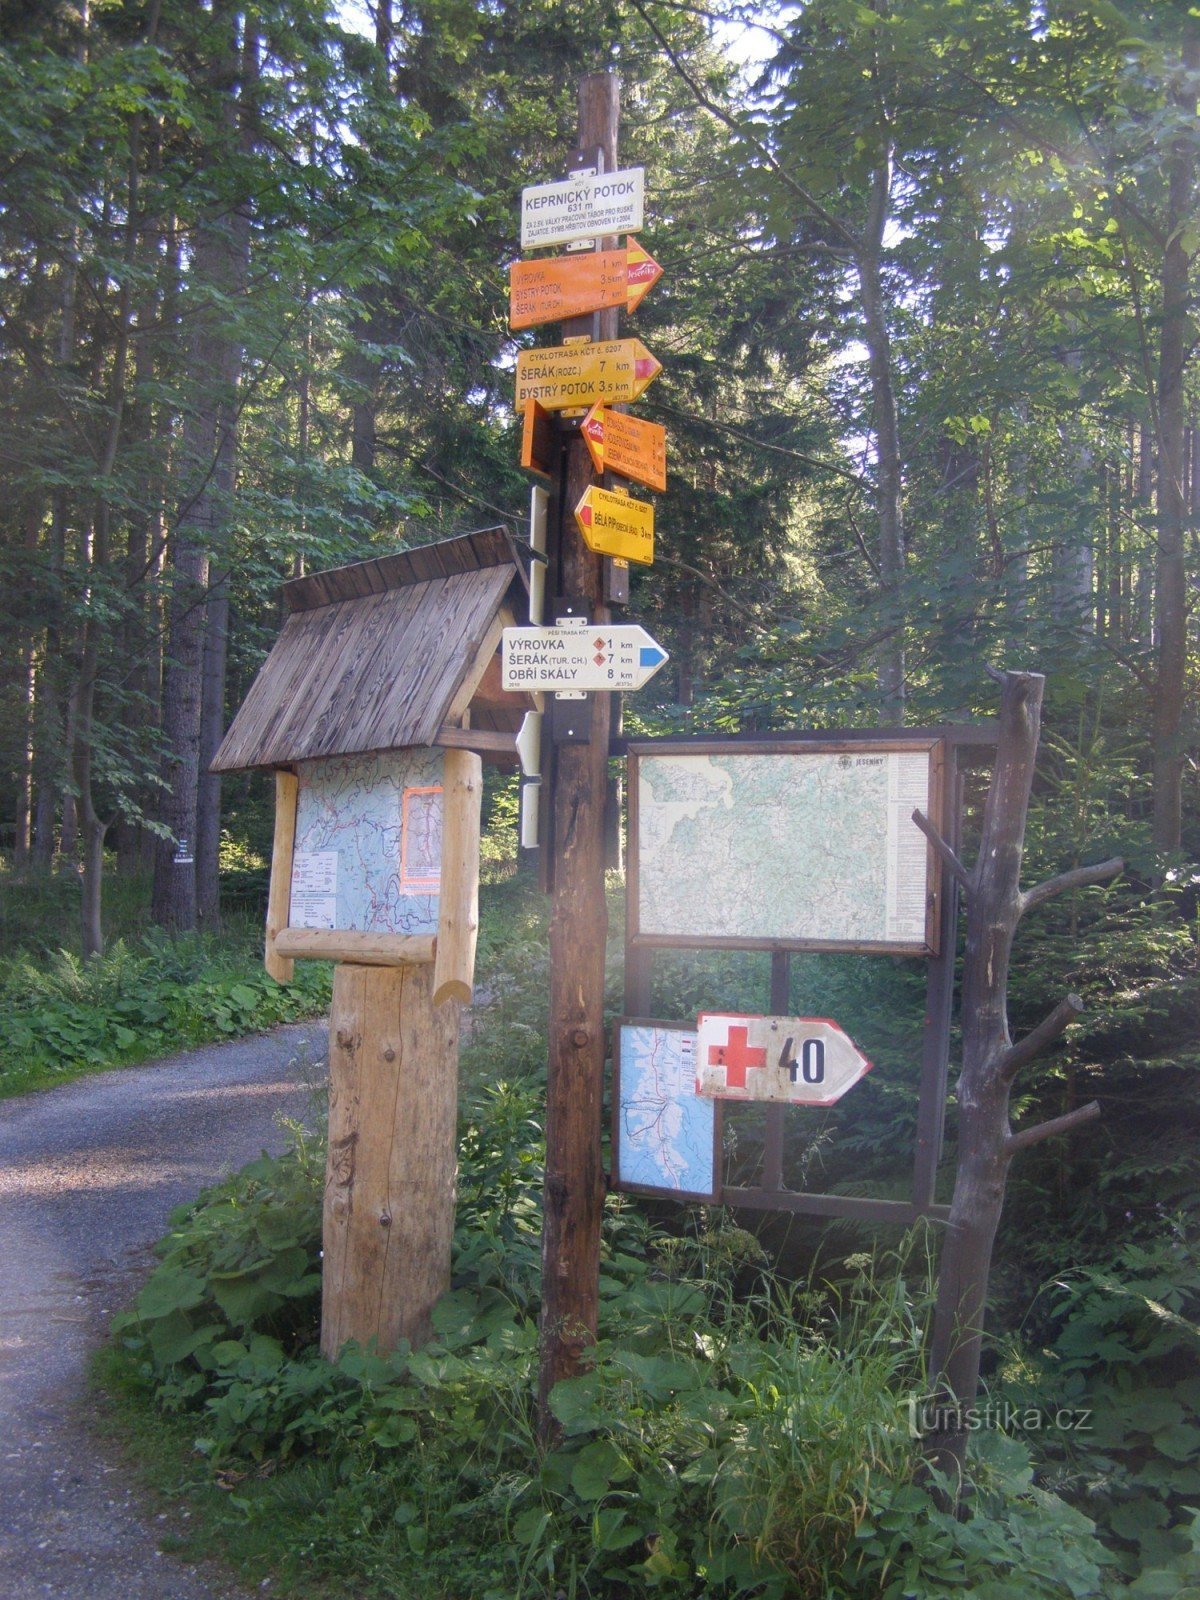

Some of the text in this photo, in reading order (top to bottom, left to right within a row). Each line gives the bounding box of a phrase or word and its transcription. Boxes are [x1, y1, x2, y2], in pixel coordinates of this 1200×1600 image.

[525, 181, 634, 211] KEPRNICKÝ POTOK
[567, 202, 593, 213] 631 m
[587, 209, 604, 220] TÁBOR
[605, 208, 616, 216] PRO
[587, 217, 611, 229] OBNOVEN
[603, 259, 607, 268] 1
[611, 260, 622, 268] km
[540, 283, 562, 296] POTOK
[612, 275, 622, 283] km
[600, 289, 606, 300] 7
[611, 290, 622, 298] km
[529, 350, 579, 362] CYKLOTRASA
[581, 347, 595, 356] KČT
[605, 345, 622, 354] 6207
[600, 360, 606, 373] 7
[615, 362, 630, 371] km
[519, 380, 629, 400] BYSTRÝ POTOK 3,5 km
[598, 492, 627, 508] CYKLOTRASA
[594, 511, 607, 527] BĚLÁ
[641, 526, 645, 538] 3
[645, 529, 652, 540] km
[509, 638, 633, 650] VÝROVKA 1 km
[509, 654, 549, 666] ŠERÁK
[549, 657, 570, 666] (TUR.
[571, 657, 588, 666] CH.)
[608, 654, 614, 664] 7
[509, 667, 537, 680] OBŘÍ
[540, 668, 578, 680] SKÁLY
[607, 669, 614, 679] 8
[856, 758, 884, 767] JESENÍKY
[778, 1037, 825, 1084] 40
